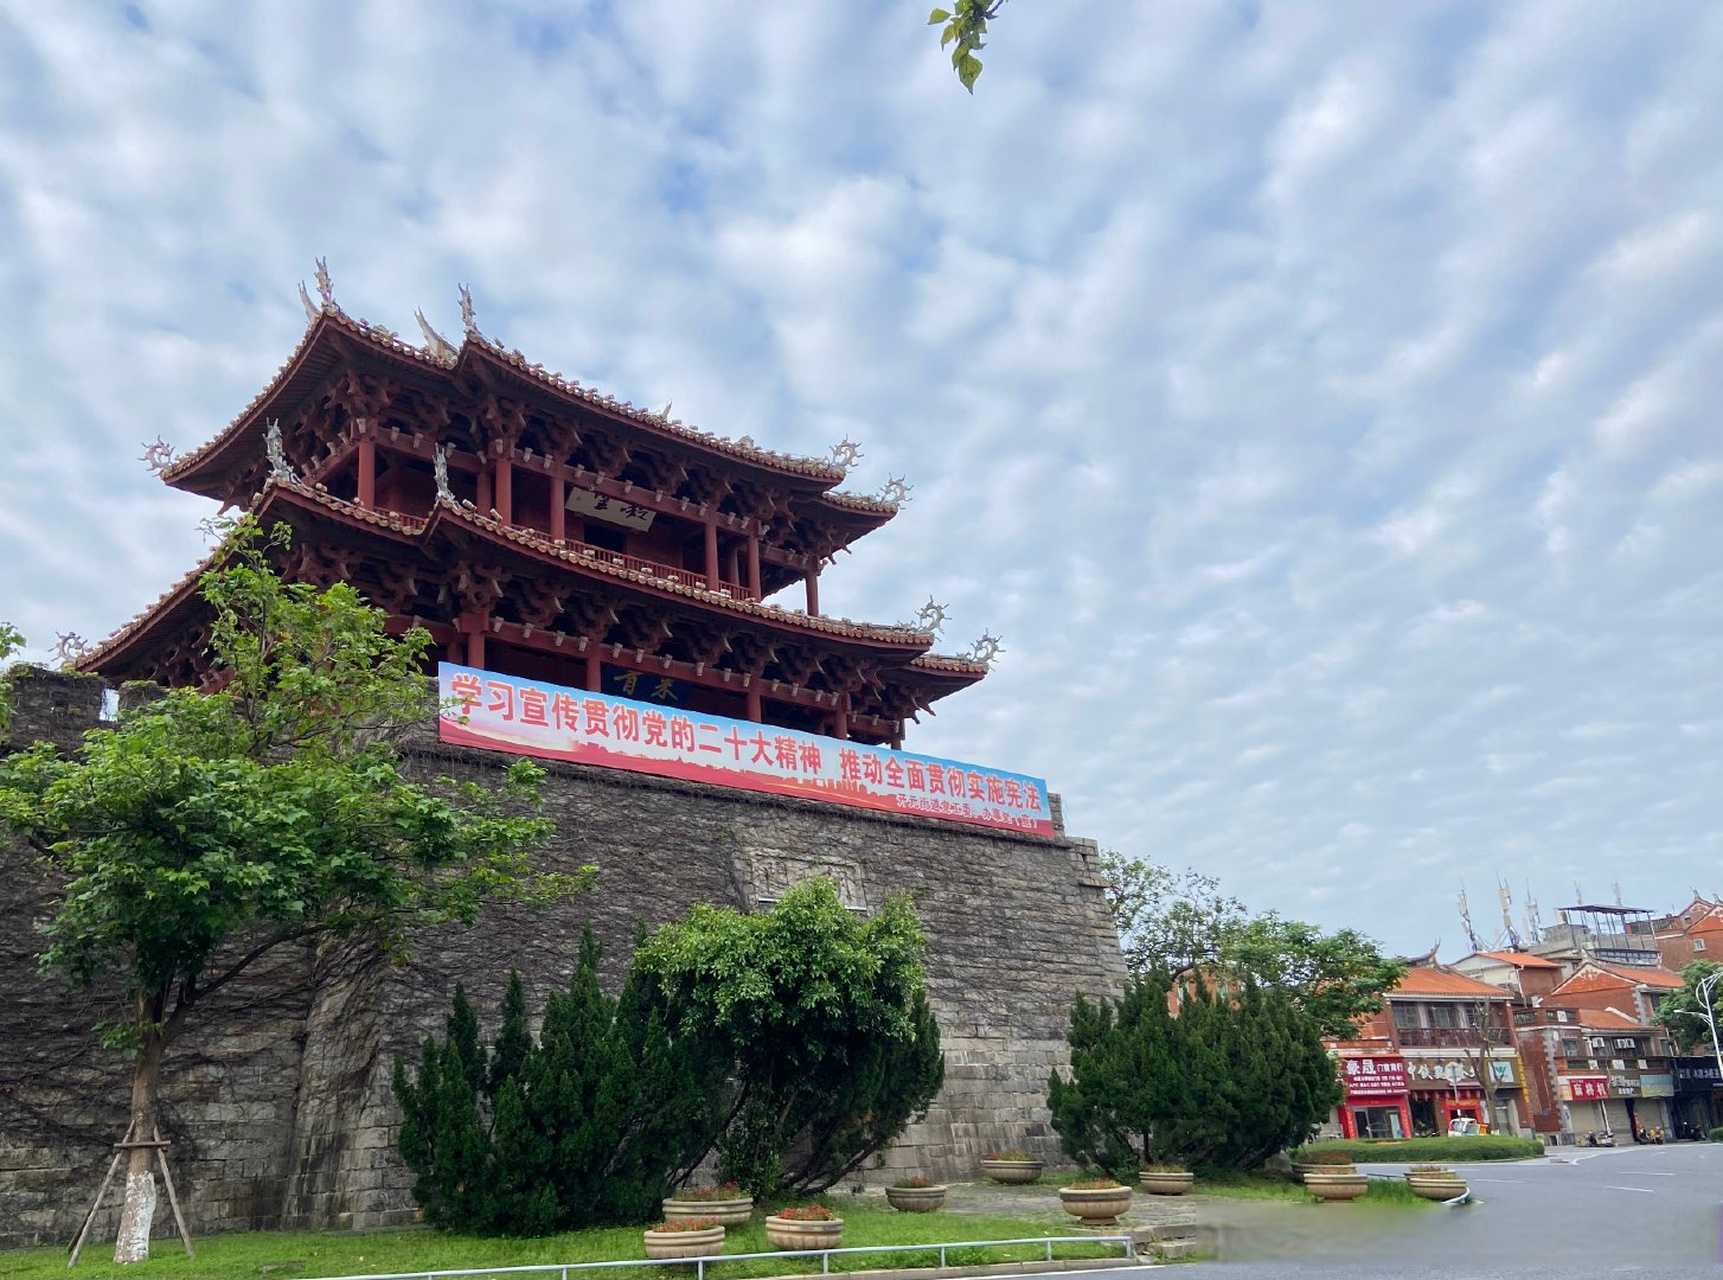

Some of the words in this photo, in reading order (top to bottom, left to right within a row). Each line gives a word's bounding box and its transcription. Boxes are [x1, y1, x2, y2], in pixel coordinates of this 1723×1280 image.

[452, 673, 821, 773] 学习宣传贯彻党的二十大精神
[840, 747, 1041, 813] 推动全面贯彻实施宪法
